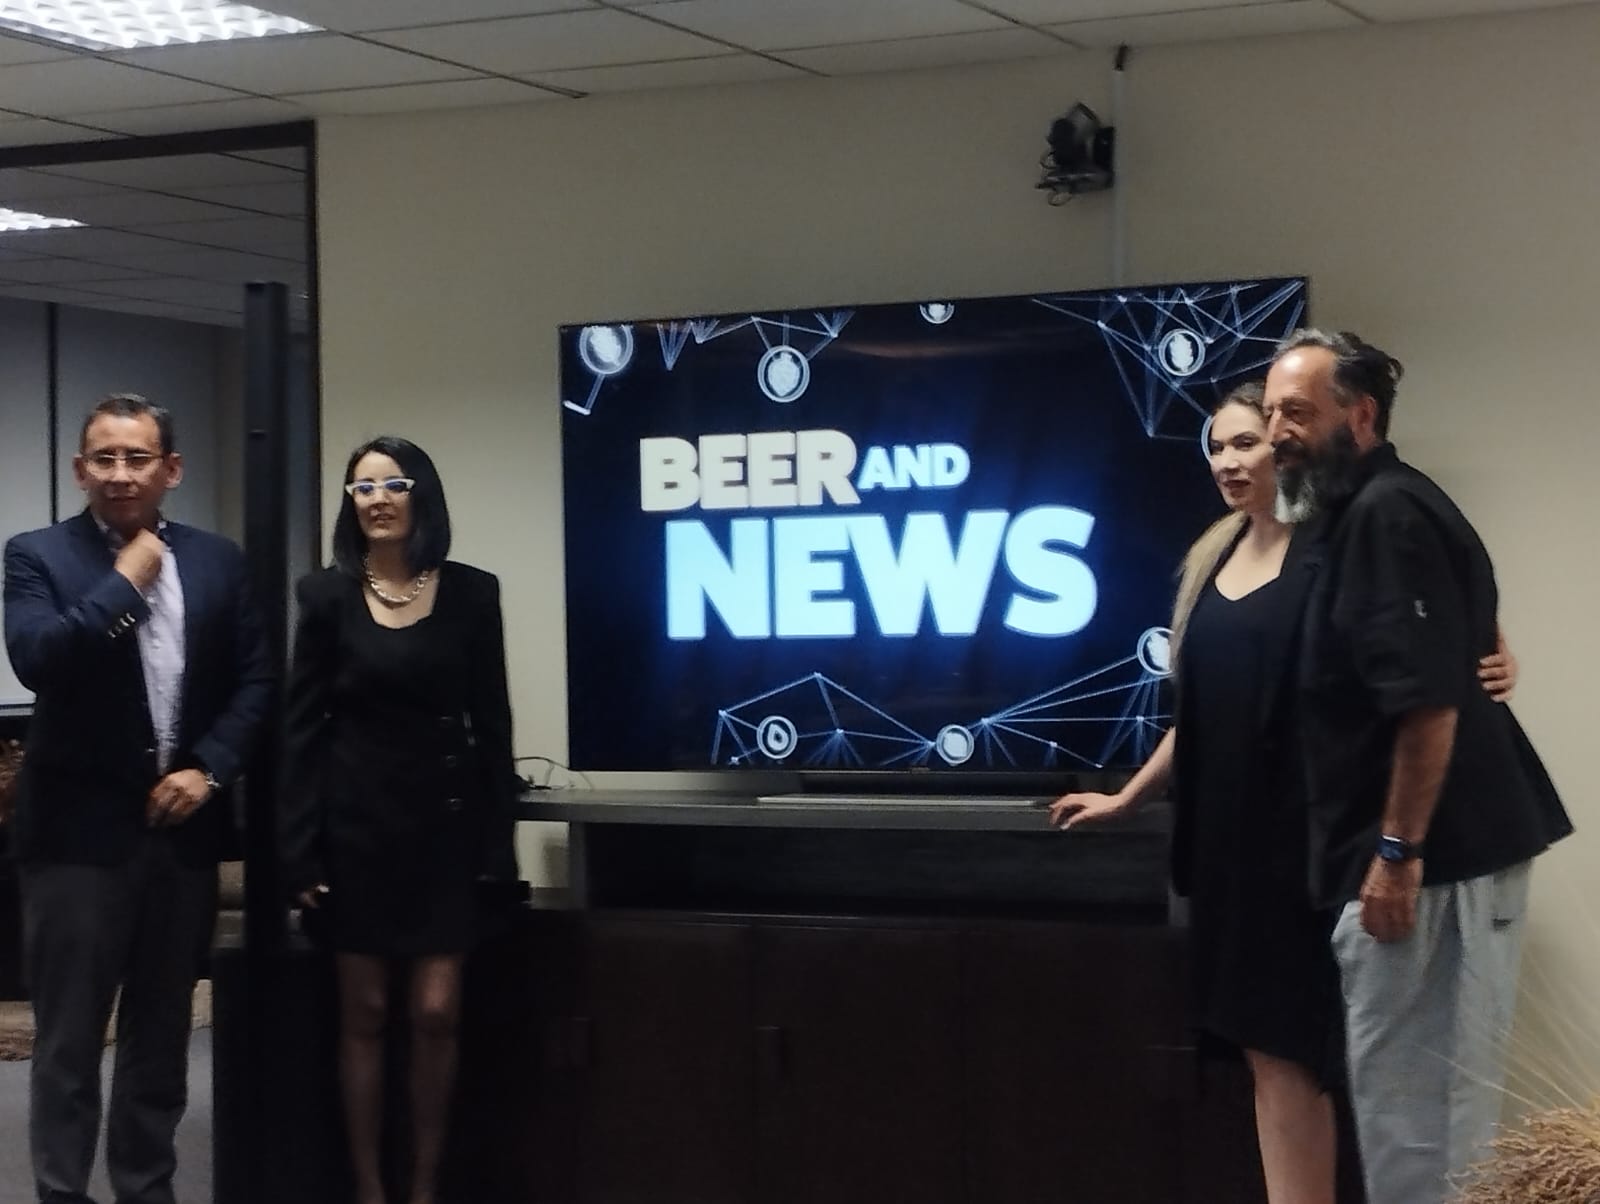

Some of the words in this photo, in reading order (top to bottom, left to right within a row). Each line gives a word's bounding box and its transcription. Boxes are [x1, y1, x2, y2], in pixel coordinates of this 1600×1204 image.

[640, 429, 861, 511] BEER
[859, 443, 970, 489] AND
[666, 505, 1097, 640] NEWS
